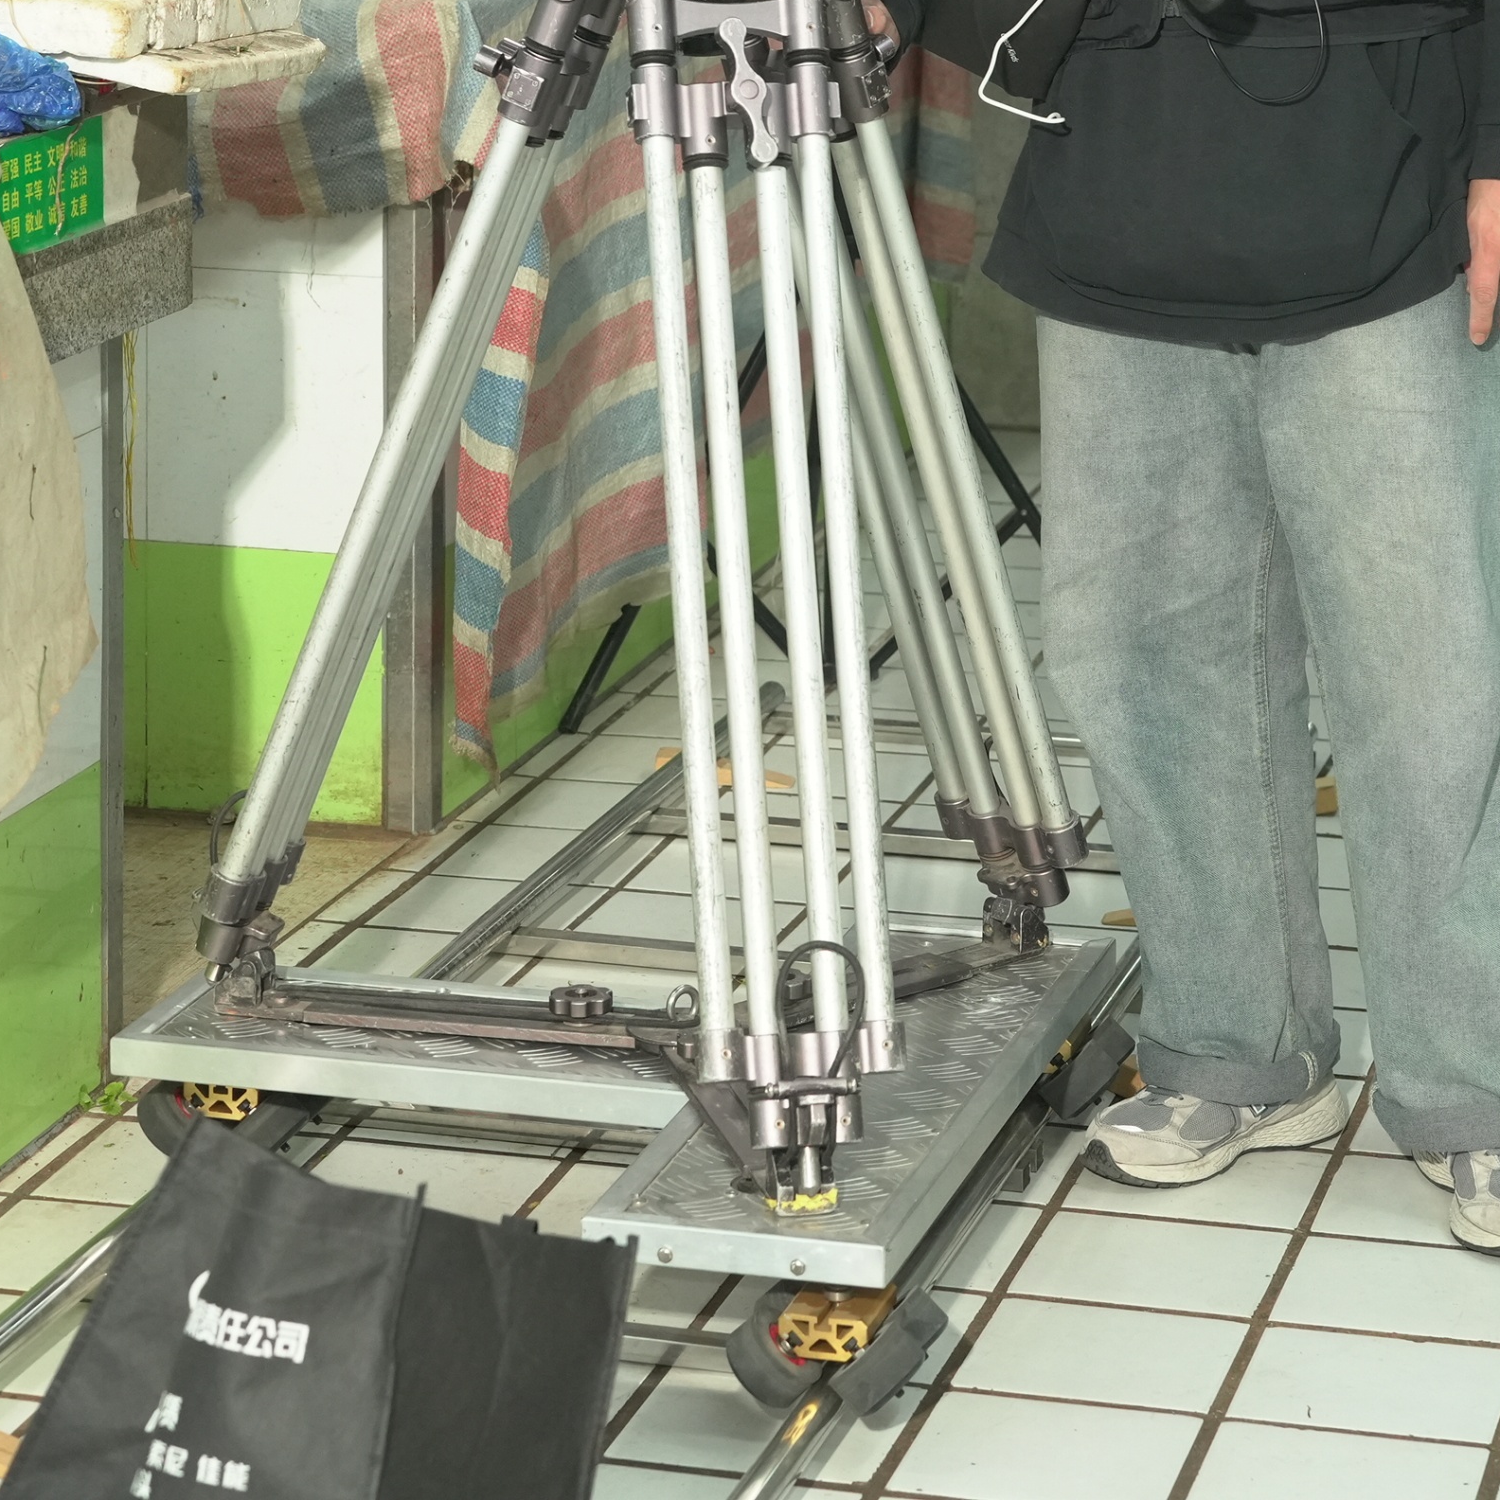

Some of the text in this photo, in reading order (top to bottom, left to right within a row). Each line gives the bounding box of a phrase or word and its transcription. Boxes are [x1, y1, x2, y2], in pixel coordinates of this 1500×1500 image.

[1, 157, 20, 183] 富强
[24, 152, 43, 176] 民主
[69, 137, 88, 161] 和谐
[2, 189, 20, 213] 自由
[25, 180, 44, 204] 平等
[70, 167, 88, 190] 法治
[25, 209, 44, 235] 敬业
[70, 195, 88, 218] 友善
